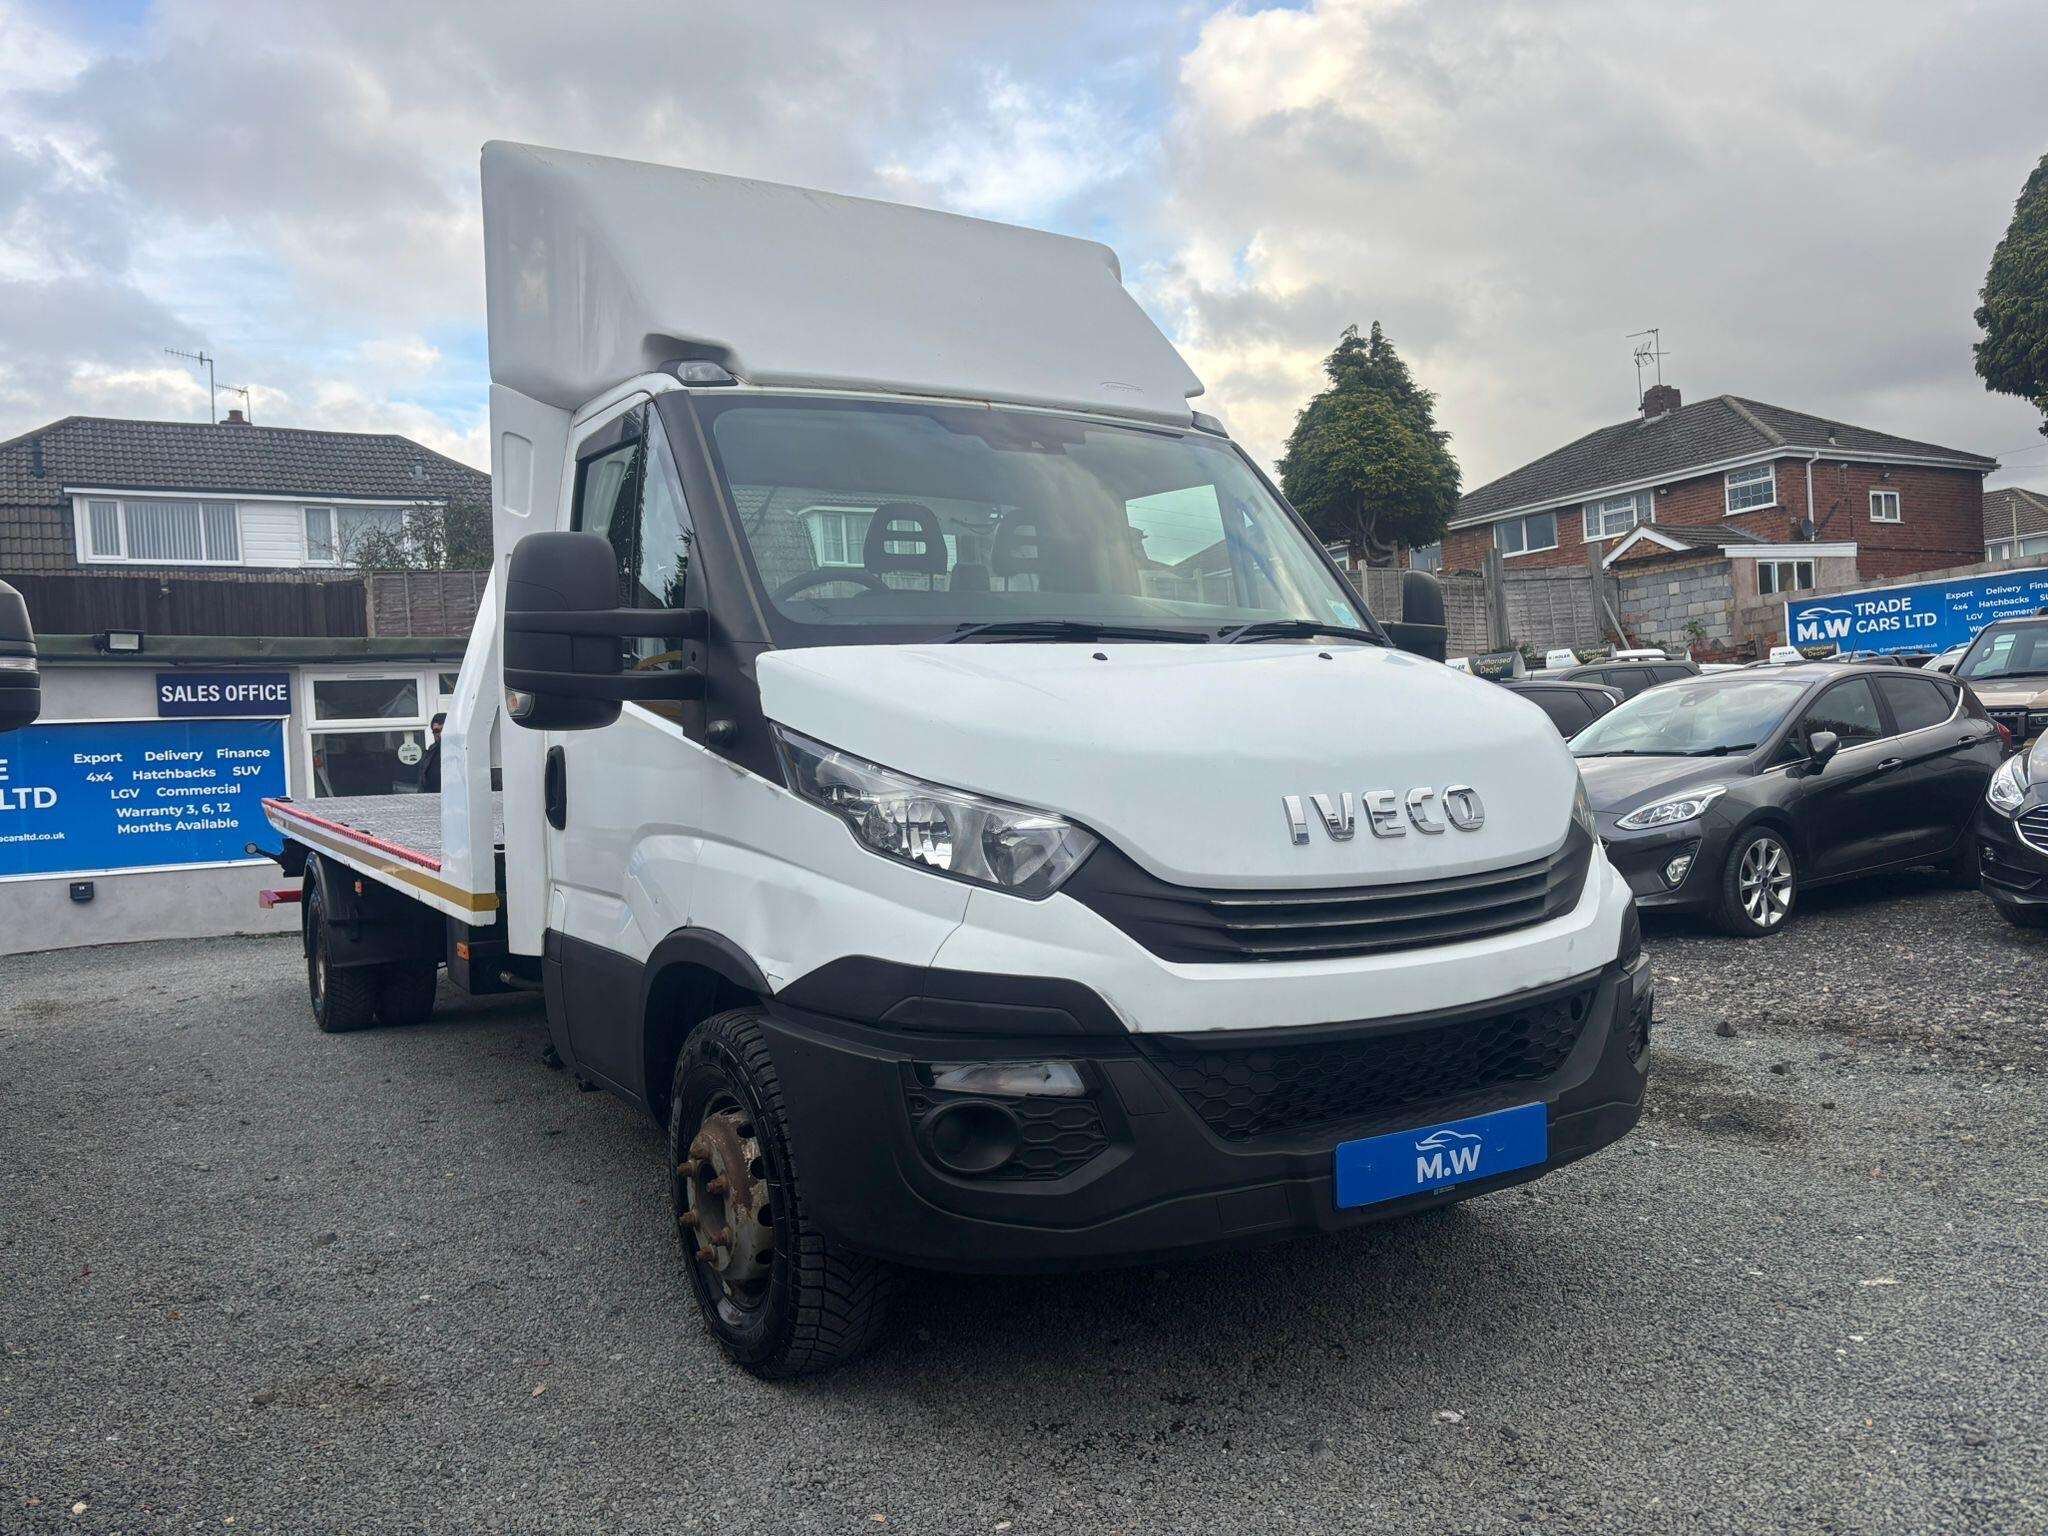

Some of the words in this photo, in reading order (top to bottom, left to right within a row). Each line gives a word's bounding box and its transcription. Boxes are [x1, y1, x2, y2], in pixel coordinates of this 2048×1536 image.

[1945, 590, 1974, 600] Export
[1985, 585, 2021, 595] Delivery
[1855, 597, 1912, 616] TRADE
[1952, 603, 1968, 611] 4x4
[1978, 596, 2029, 608] Hatchbacks
[1855, 617, 1901, 633] CARS
[1905, 612, 1937, 629] LTD
[1966, 613, 1983, 621] LGV
[1796, 617, 1852, 642] M.W
[1475, 656, 1512, 666] Authorised
[1480, 664, 1503, 674] Dealer
[161, 685, 220, 702] SALES
[225, 684, 287, 701] OFFICE
[73, 752, 123, 765] Export
[144, 749, 204, 762] Delivery
[216, 748, 271, 759] Finance
[86, 771, 114, 782] 4x4
[132, 767, 216, 781] Hatchbacks
[232, 765, 261, 776] SUV
[0, 786, 58, 811] LTD
[111, 788, 140, 800] LGV
[156, 783, 241, 797] Commercial
[116, 804, 184, 818] Warranty
[186, 803, 199, 815] 3,
[202, 803, 215, 815] 6,
[217, 802, 231, 813] 12
[1282, 784, 1486, 846] IVECO
[117, 819, 172, 835] Months
[175, 817, 239, 831] Available
[1416, 1143, 1482, 1184] M.W
